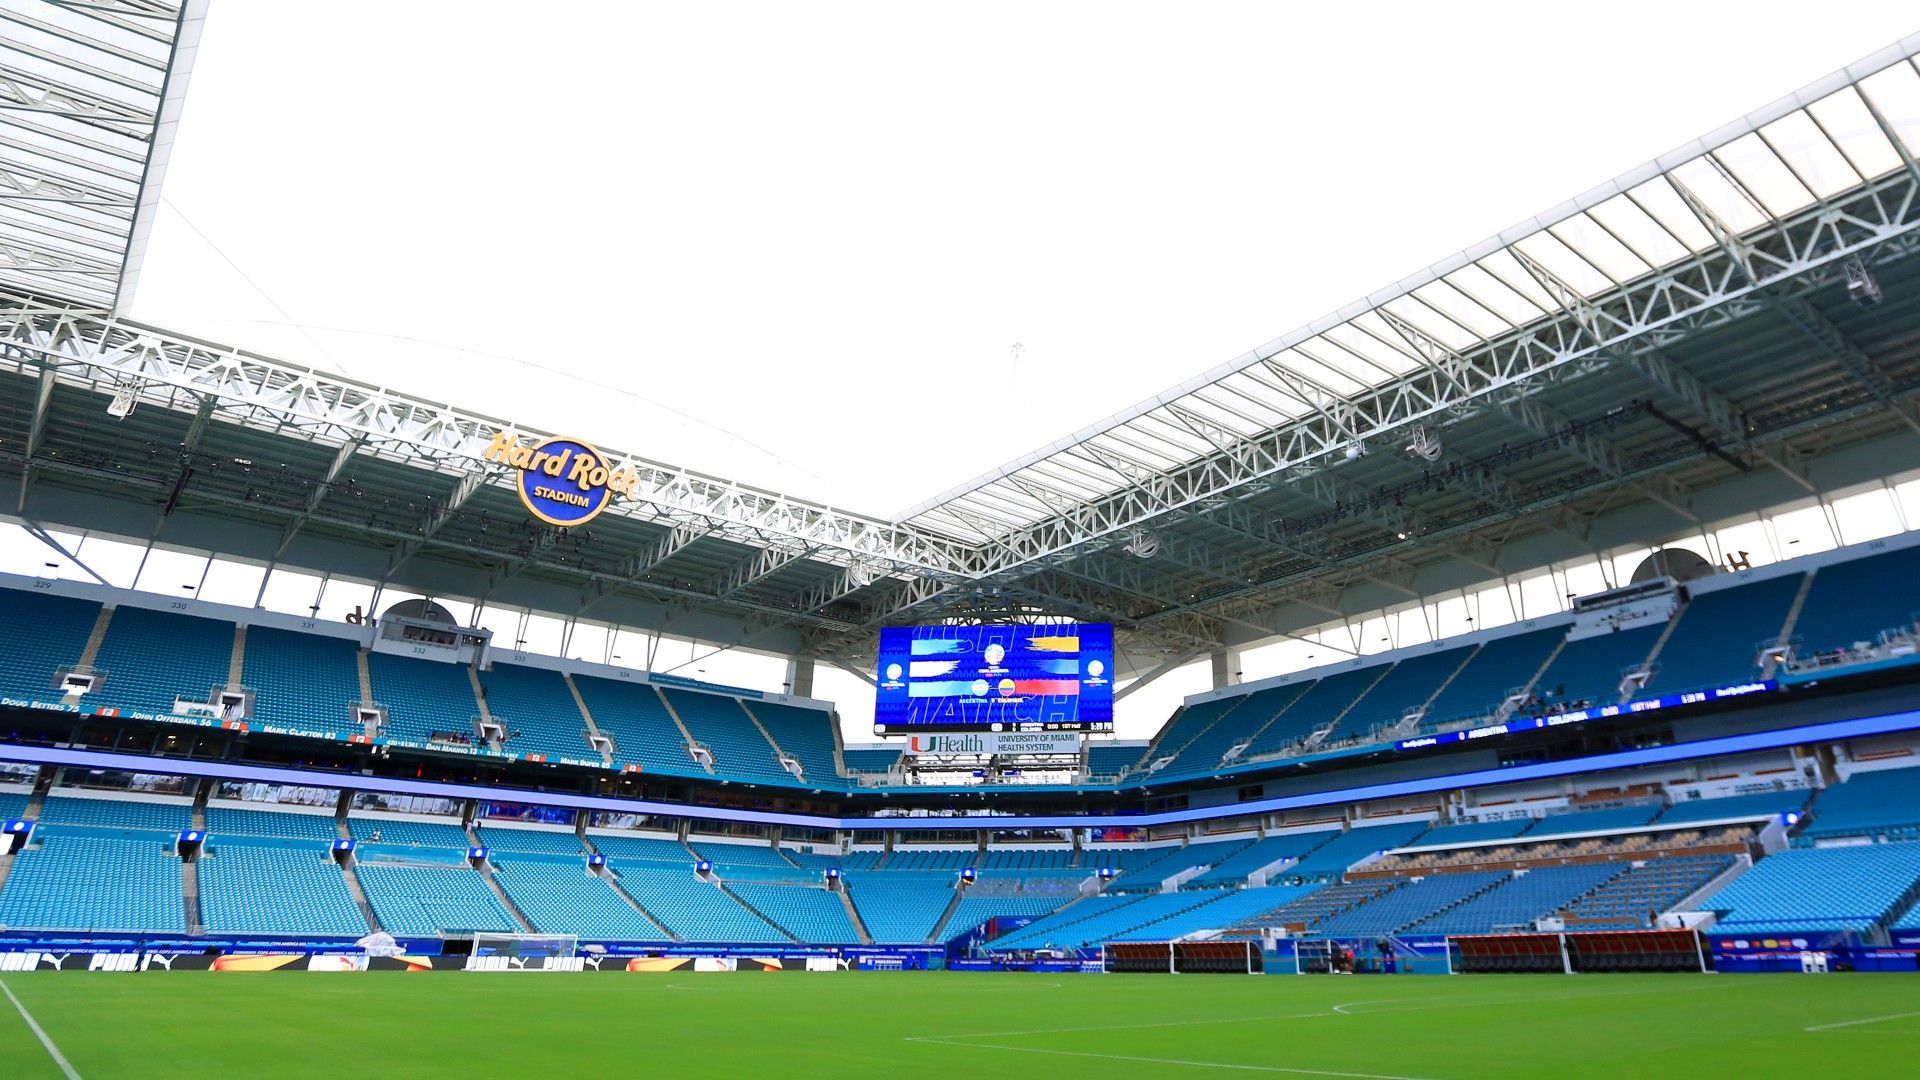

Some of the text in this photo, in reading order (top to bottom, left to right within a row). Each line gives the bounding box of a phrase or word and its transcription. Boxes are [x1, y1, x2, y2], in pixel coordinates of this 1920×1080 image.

[485, 432, 641, 502] Hard Rock
[534, 486, 590, 508] STADIUM
[34, 580, 52, 589] 329
[171, 601, 187, 610] 330
[301, 621, 314, 629] 331
[31, 702, 65, 712] BETTERS
[67, 705, 80, 713] 75
[131, 711, 153, 721] JOHN
[200, 718, 212, 727] 56
[263, 725, 336, 740] MARK CLAYTON 83
[1041, 734, 1050, 742] OF
[1051, 733, 1075, 742] MIAMI
[426, 743, 440, 751] DAN
[441, 745, 468, 754] MARINO
[998, 743, 1054, 751] HEALTH SYSTEM
[543, 956, 585, 971] PUMA
